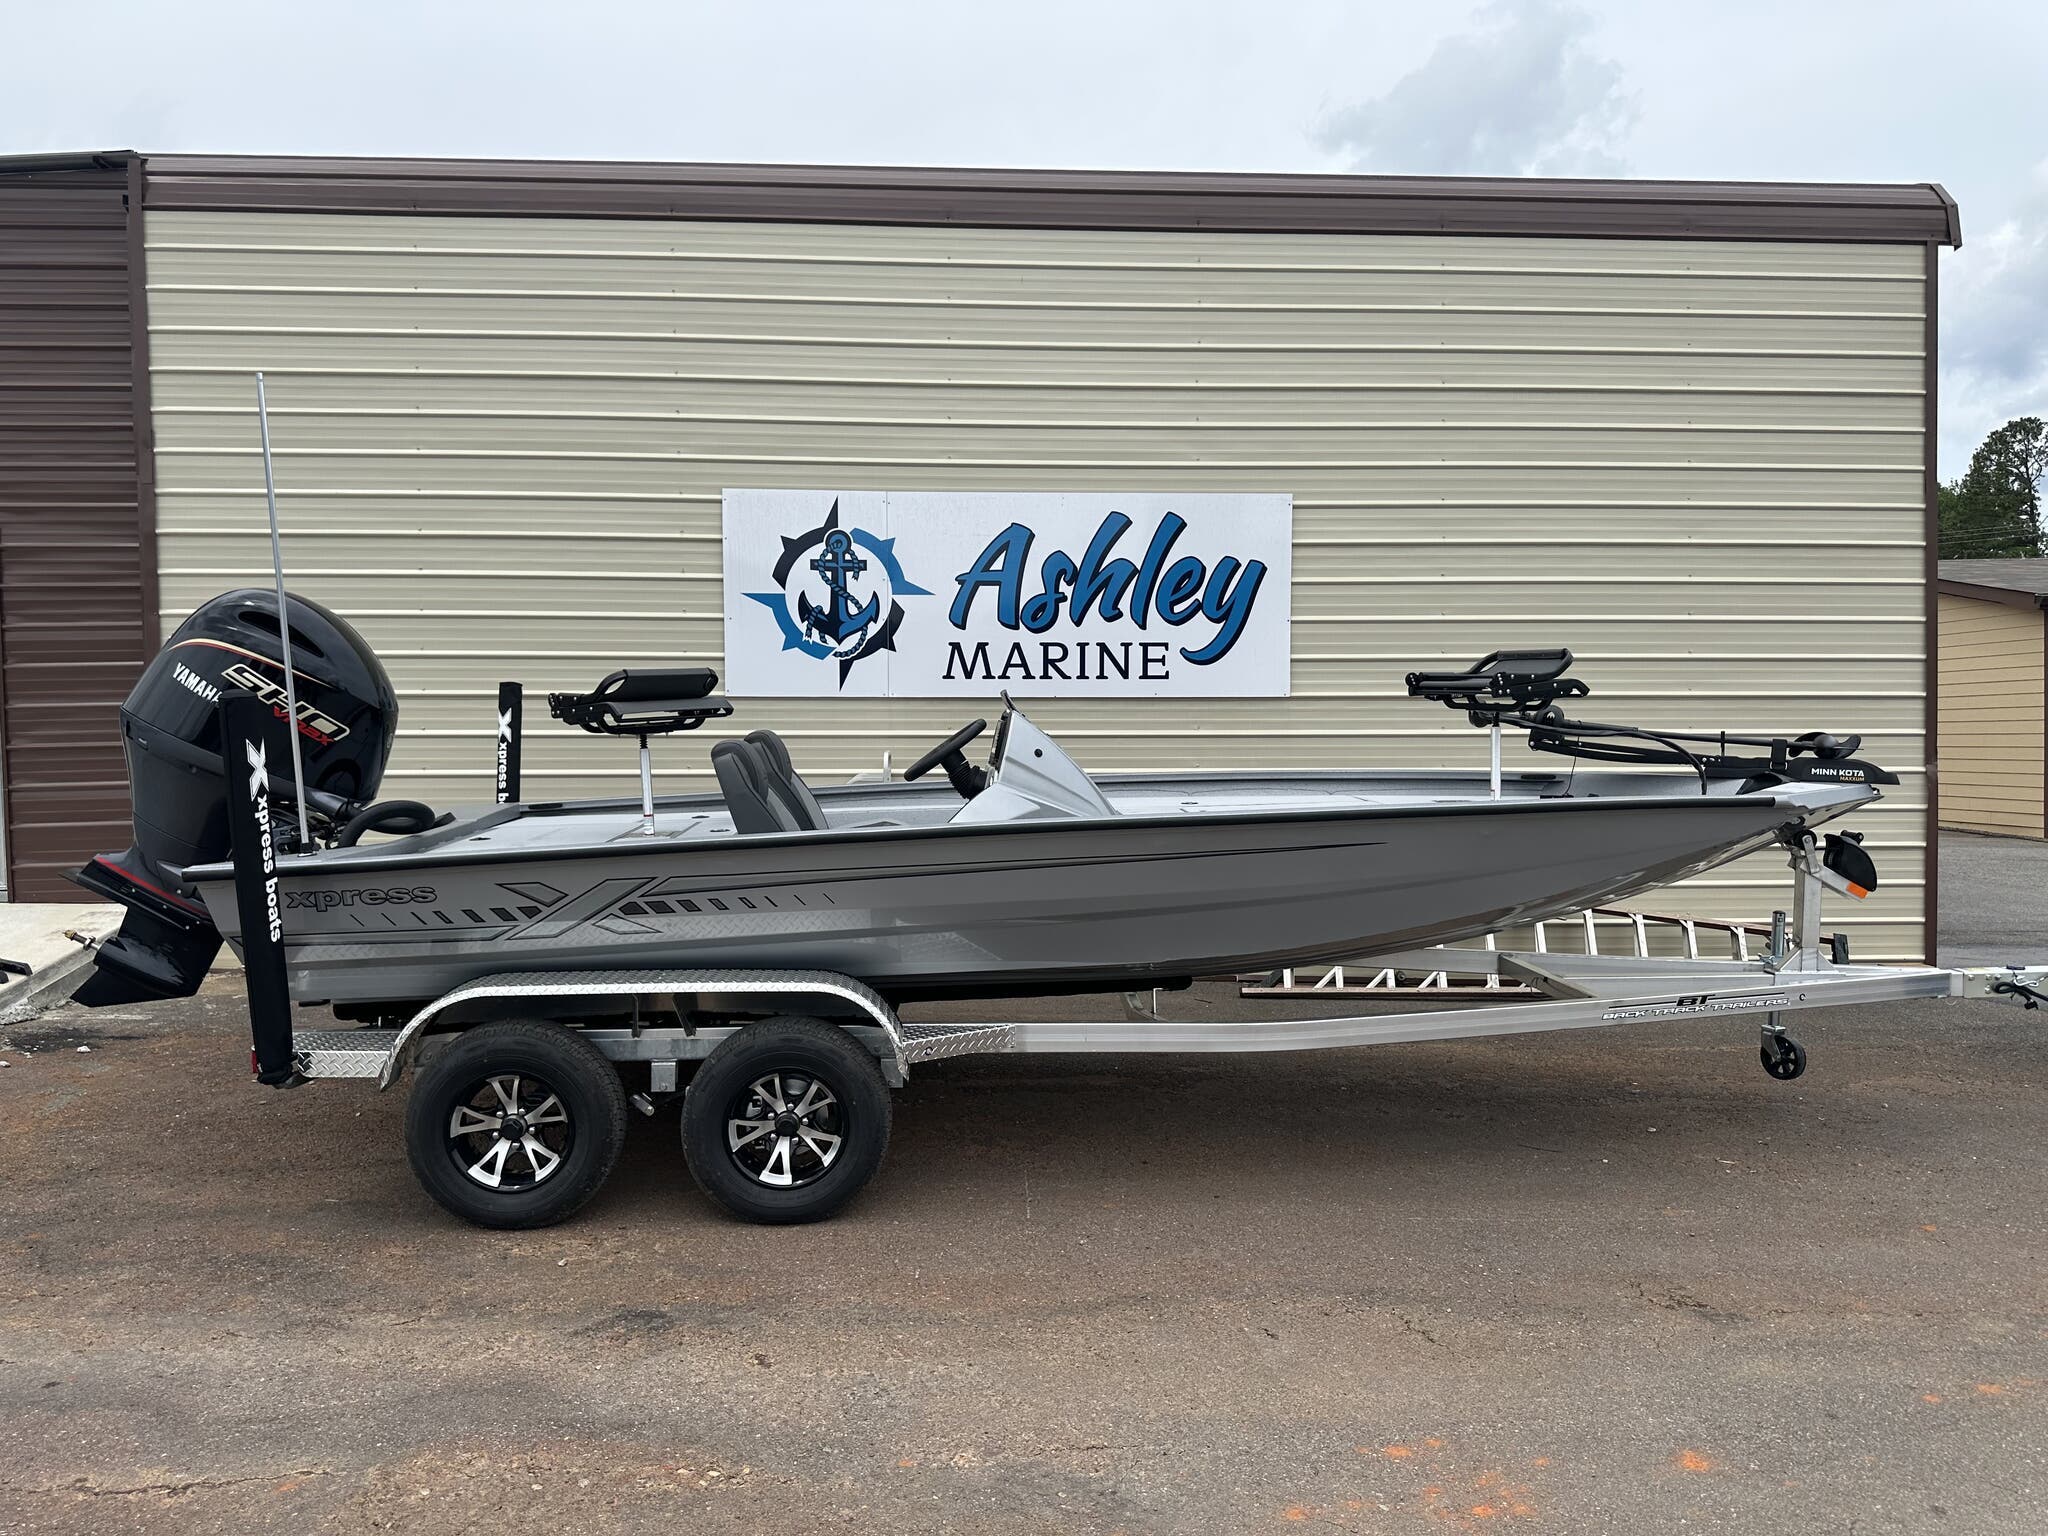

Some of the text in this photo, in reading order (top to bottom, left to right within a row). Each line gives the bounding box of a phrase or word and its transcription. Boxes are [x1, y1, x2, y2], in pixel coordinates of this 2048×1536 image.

[949, 510, 1268, 666] Ashley
[942, 641, 1170, 680] MARINE
[498, 742, 508, 790] xpress
[1811, 767, 1865, 777] MINN KOTA
[254, 794, 275, 874] xpress
[265, 877, 282, 943] boats
[285, 886, 438, 912] xpress
[1602, 1009, 1649, 1020] BACK
[1651, 1004, 1709, 1016] TRACK
